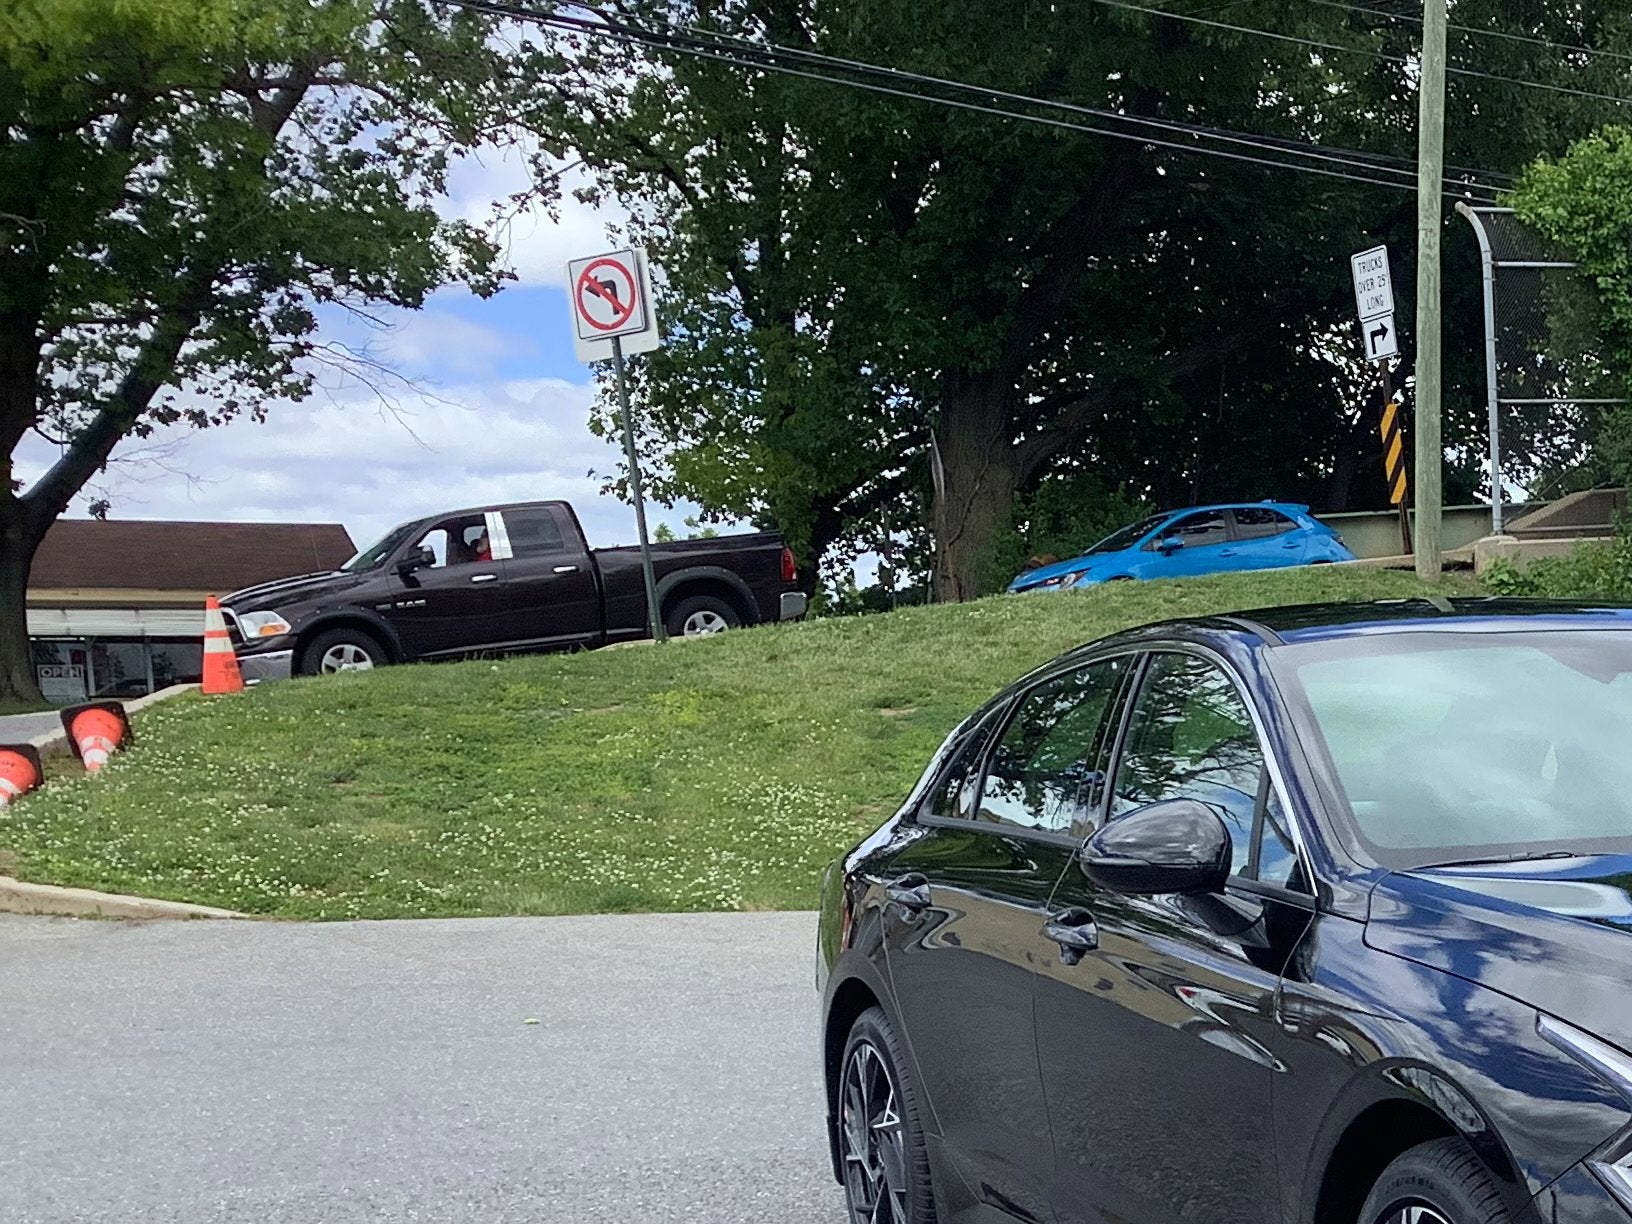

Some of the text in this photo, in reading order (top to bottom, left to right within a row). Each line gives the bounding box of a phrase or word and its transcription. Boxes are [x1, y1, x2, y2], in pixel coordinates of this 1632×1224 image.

[1358, 256, 1383, 274] TRUCKS
[1358, 278, 1375, 294] OVER
[1366, 294, 1384, 310] LONG
[41, 666, 80, 678] OPEN
